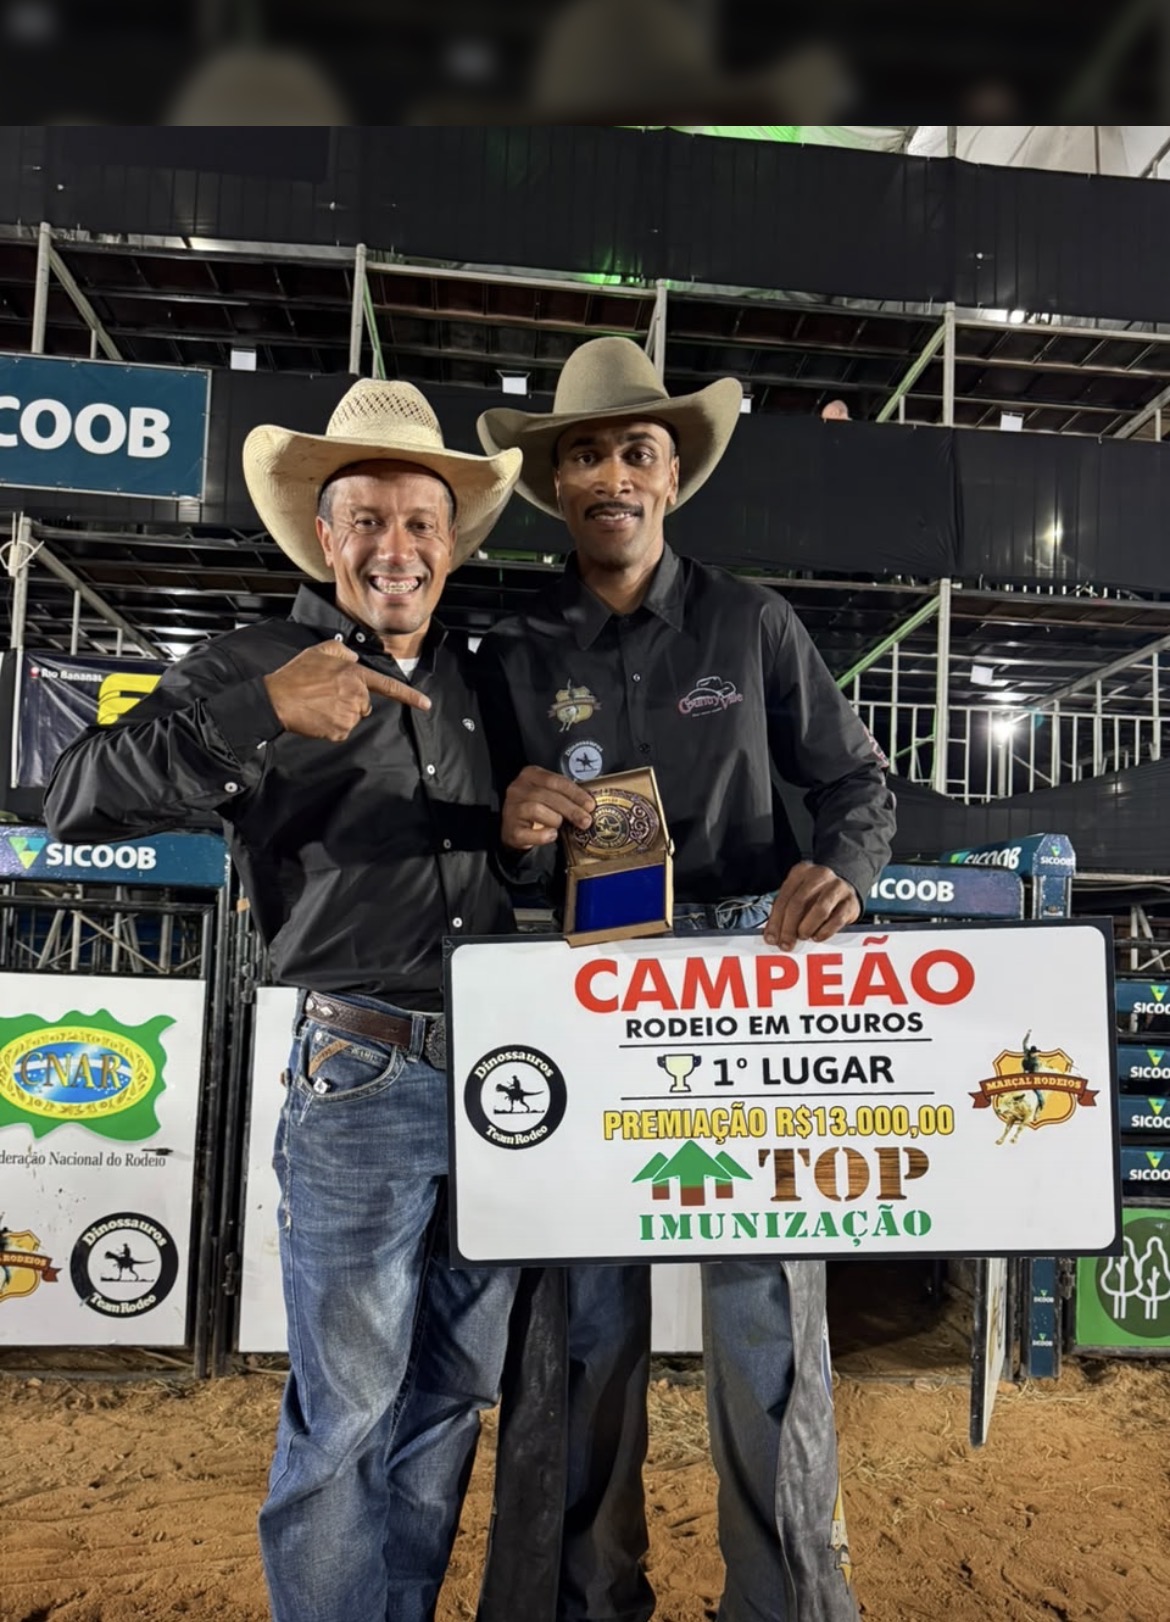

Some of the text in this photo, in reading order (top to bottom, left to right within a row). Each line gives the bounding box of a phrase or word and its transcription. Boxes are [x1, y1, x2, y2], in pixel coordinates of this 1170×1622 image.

[45, 843, 157, 870] SICOOB
[868, 877, 955, 902] ICOOB
[574, 934, 976, 1014] CAMPEÃO
[625, 1012, 925, 1039] RODEIO EM TOUROS
[20, 1050, 123, 1089] CNAR
[473, 1050, 554, 1080] Dinossauros
[762, 1055, 895, 1086] LUGAR
[985, 1076, 1082, 1091] MARÇAL RODEIOS
[485, 1124, 548, 1145] Team Rodeo
[603, 1101, 955, 1145] PREMIAÇÃO R$13.000,00
[50, 1151, 103, 1167] Nacional
[106, 1152, 122, 1167] do
[125, 1152, 167, 1168] Rodeio
[758, 1146, 930, 1202] TOP
[82, 1218, 168, 1247] Dinossauros
[639, 1204, 932, 1247] IMUNIZAÇÃO
[90, 1291, 157, 1313] Team Rodeo
